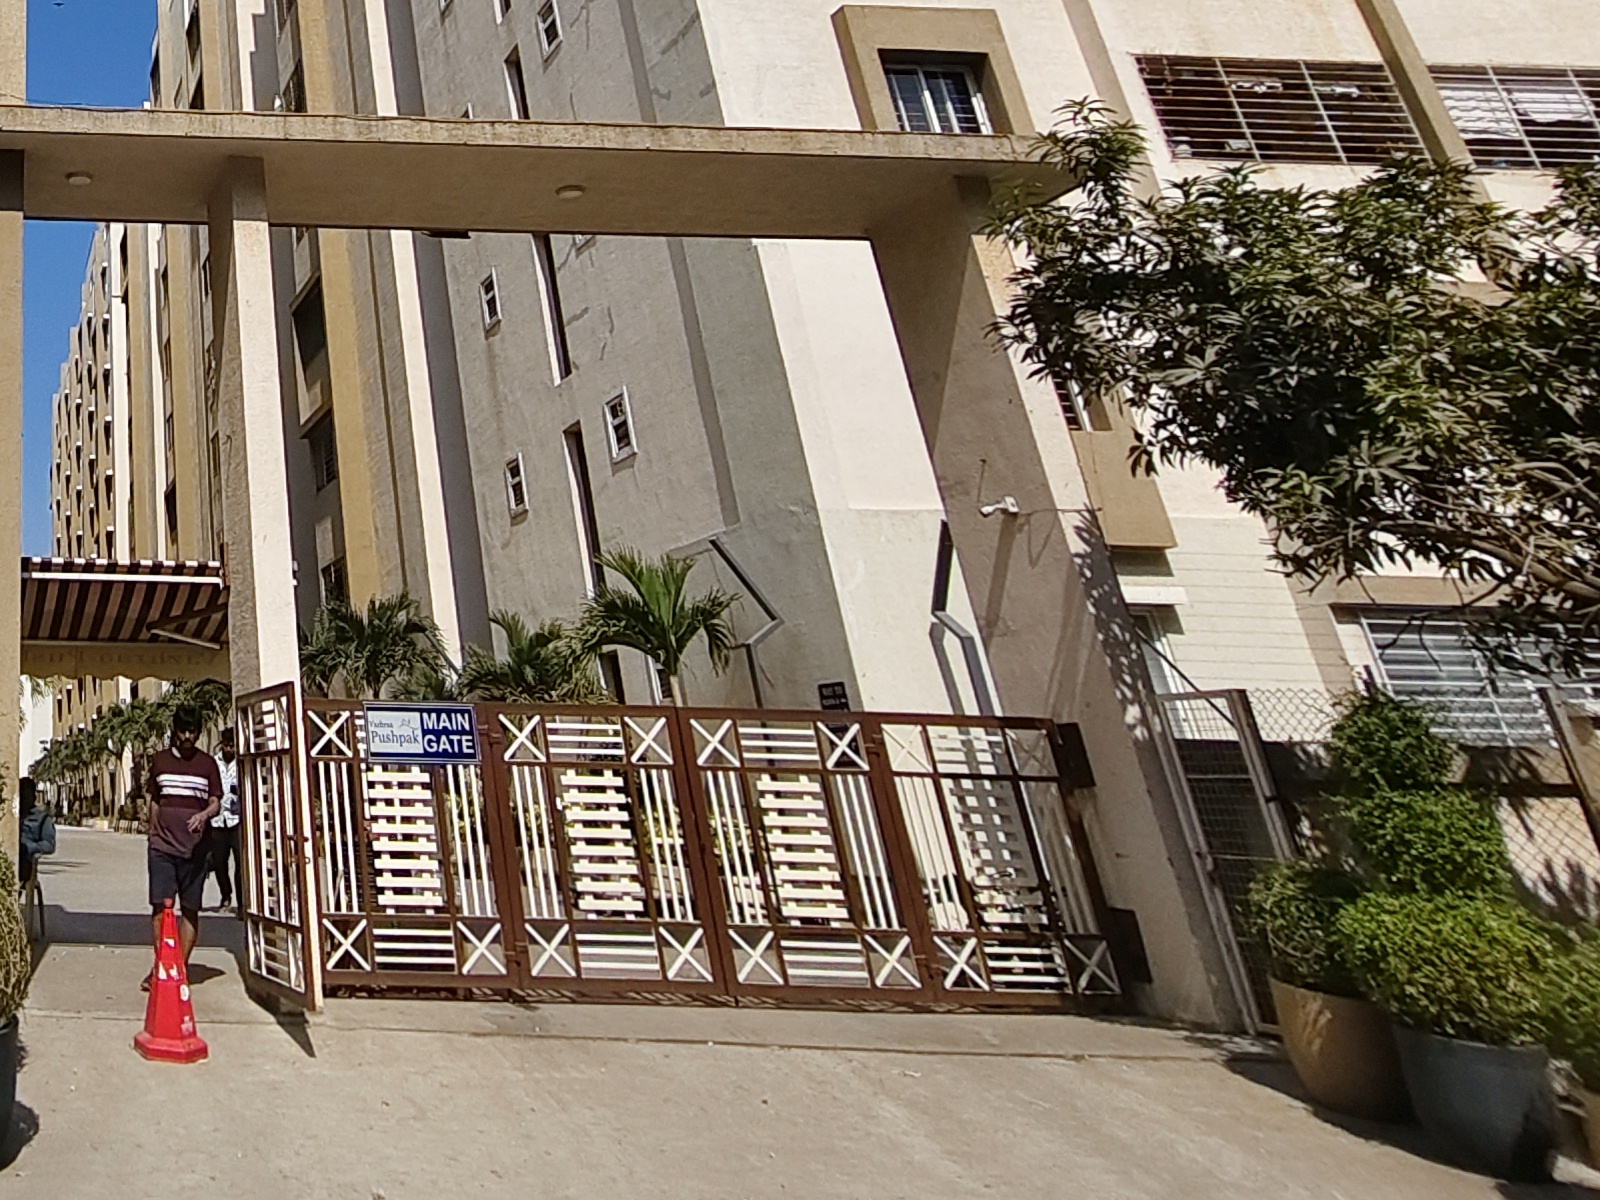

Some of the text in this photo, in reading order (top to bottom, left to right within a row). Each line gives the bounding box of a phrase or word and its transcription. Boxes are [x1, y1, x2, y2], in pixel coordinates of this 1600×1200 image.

[422, 712, 470, 731] MAIN
[371, 730, 420, 747] Pushpak
[423, 735, 475, 753] GATE
